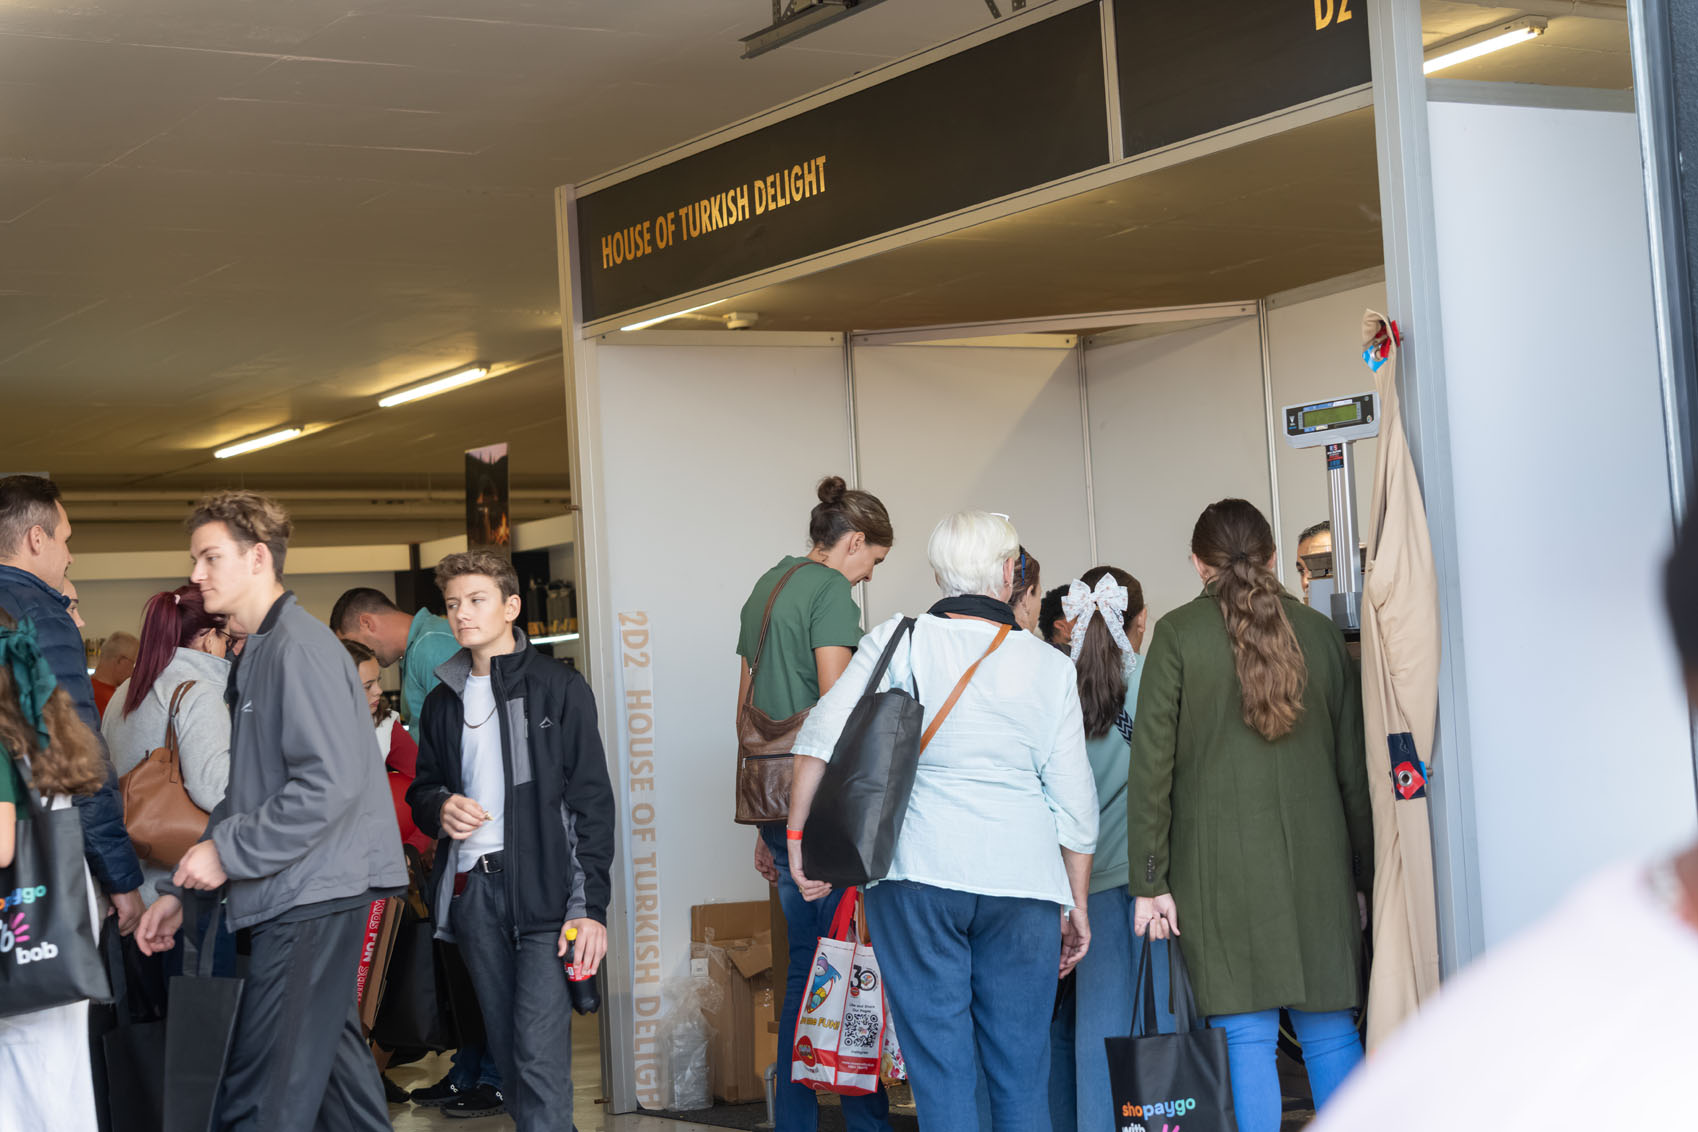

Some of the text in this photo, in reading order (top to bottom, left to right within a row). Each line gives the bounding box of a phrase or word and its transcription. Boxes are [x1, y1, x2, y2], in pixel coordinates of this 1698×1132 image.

[601, 155, 827, 269] HOUSE OF TURKISH DELIGHT
[618, 611, 650, 668] 2D2
[626, 690, 655, 792] HOUSE
[631, 802, 657, 842] OF
[633, 852, 660, 984] TURKISH
[15, 941, 59, 965] bob
[363, 932, 378, 962] FUN
[850, 964, 877, 991] 30
[1122, 1098, 1196, 1120] shopaygo
